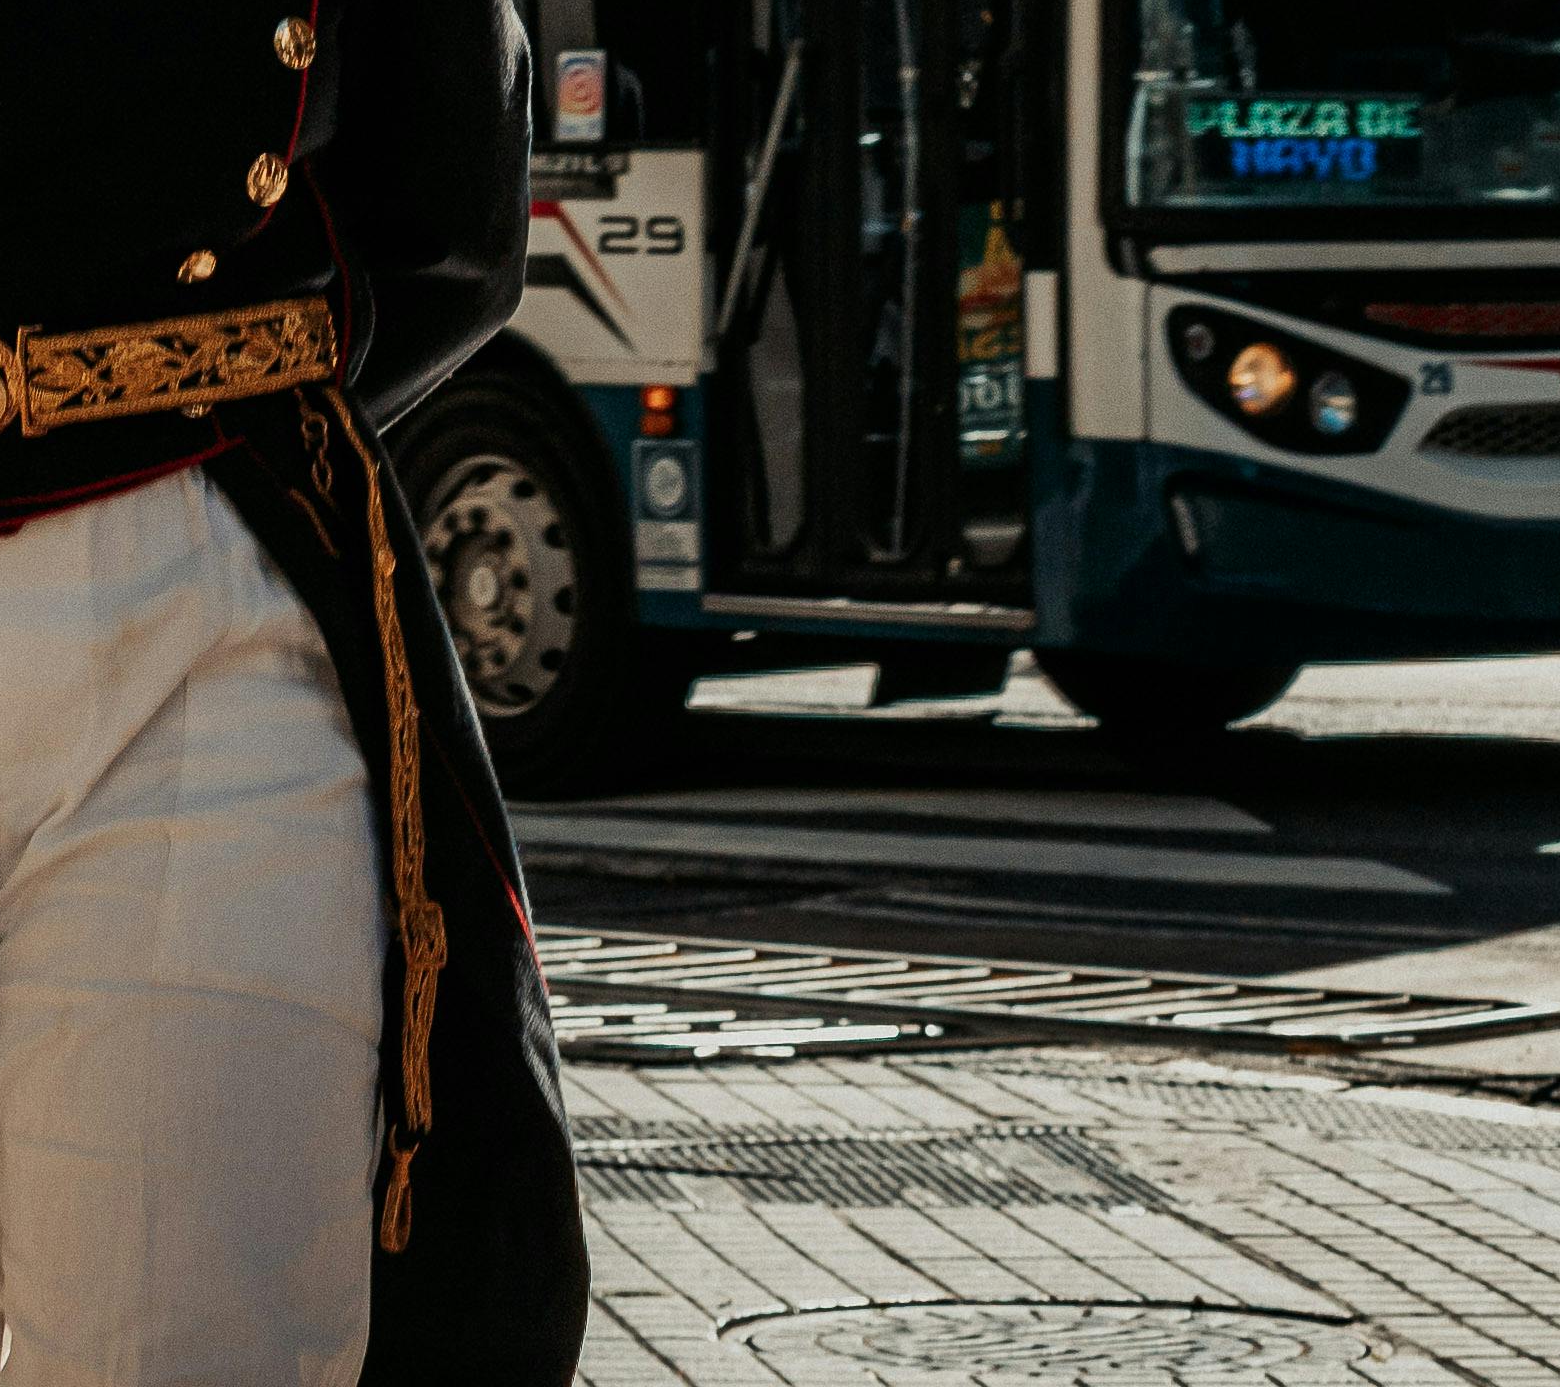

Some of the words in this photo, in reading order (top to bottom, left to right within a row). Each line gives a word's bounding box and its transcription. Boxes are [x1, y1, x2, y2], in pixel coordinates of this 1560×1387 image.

[1187, 98, 1350, 138] PLAZA
[1231, 138, 1377, 181] MAYO
[597, 214, 687, 256] 29
